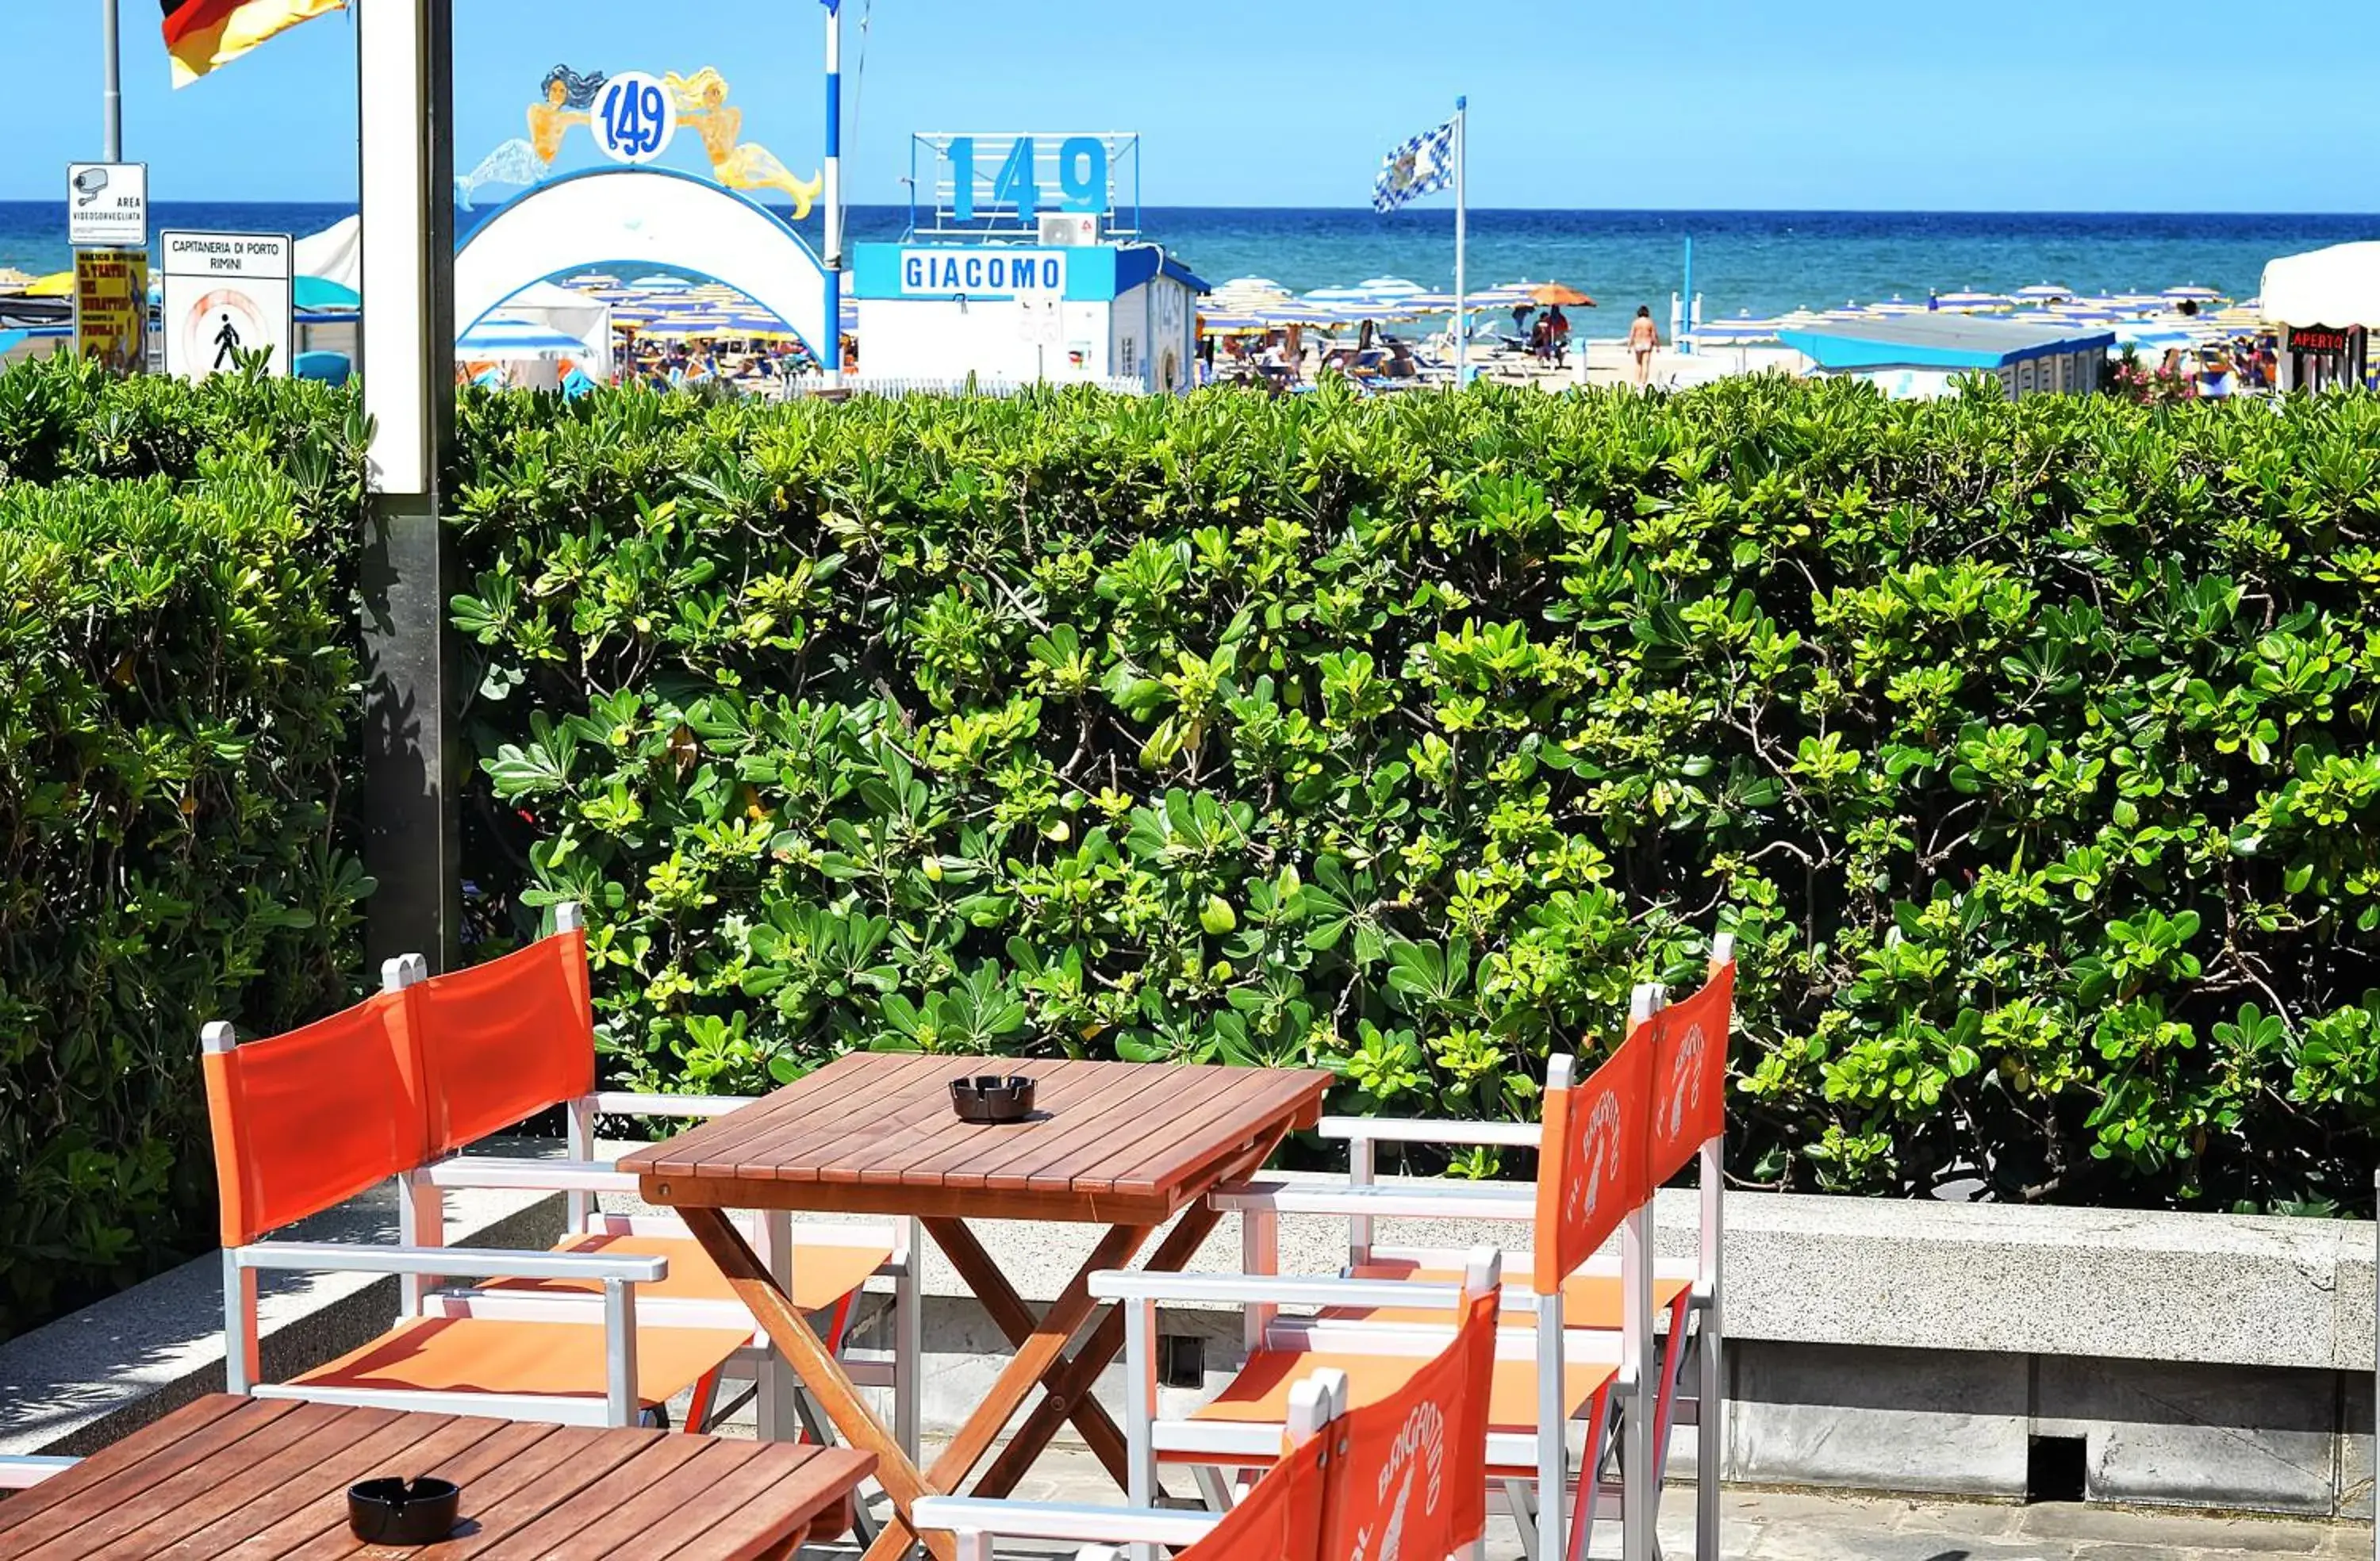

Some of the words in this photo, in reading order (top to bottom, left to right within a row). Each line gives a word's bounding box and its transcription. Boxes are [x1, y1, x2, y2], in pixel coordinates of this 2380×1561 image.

[600, 80, 665, 155] 149
[947, 136, 1107, 221] 149
[117, 197, 140, 208] AREA
[172, 240, 231, 254] CAPITANERIA
[234, 243, 244, 254] DI
[247, 244, 279, 255] PORTO
[210, 258, 241, 270] RIMINI
[907, 257, 1059, 289] GIACOMO
[2293, 332, 2344, 350] APERTO
